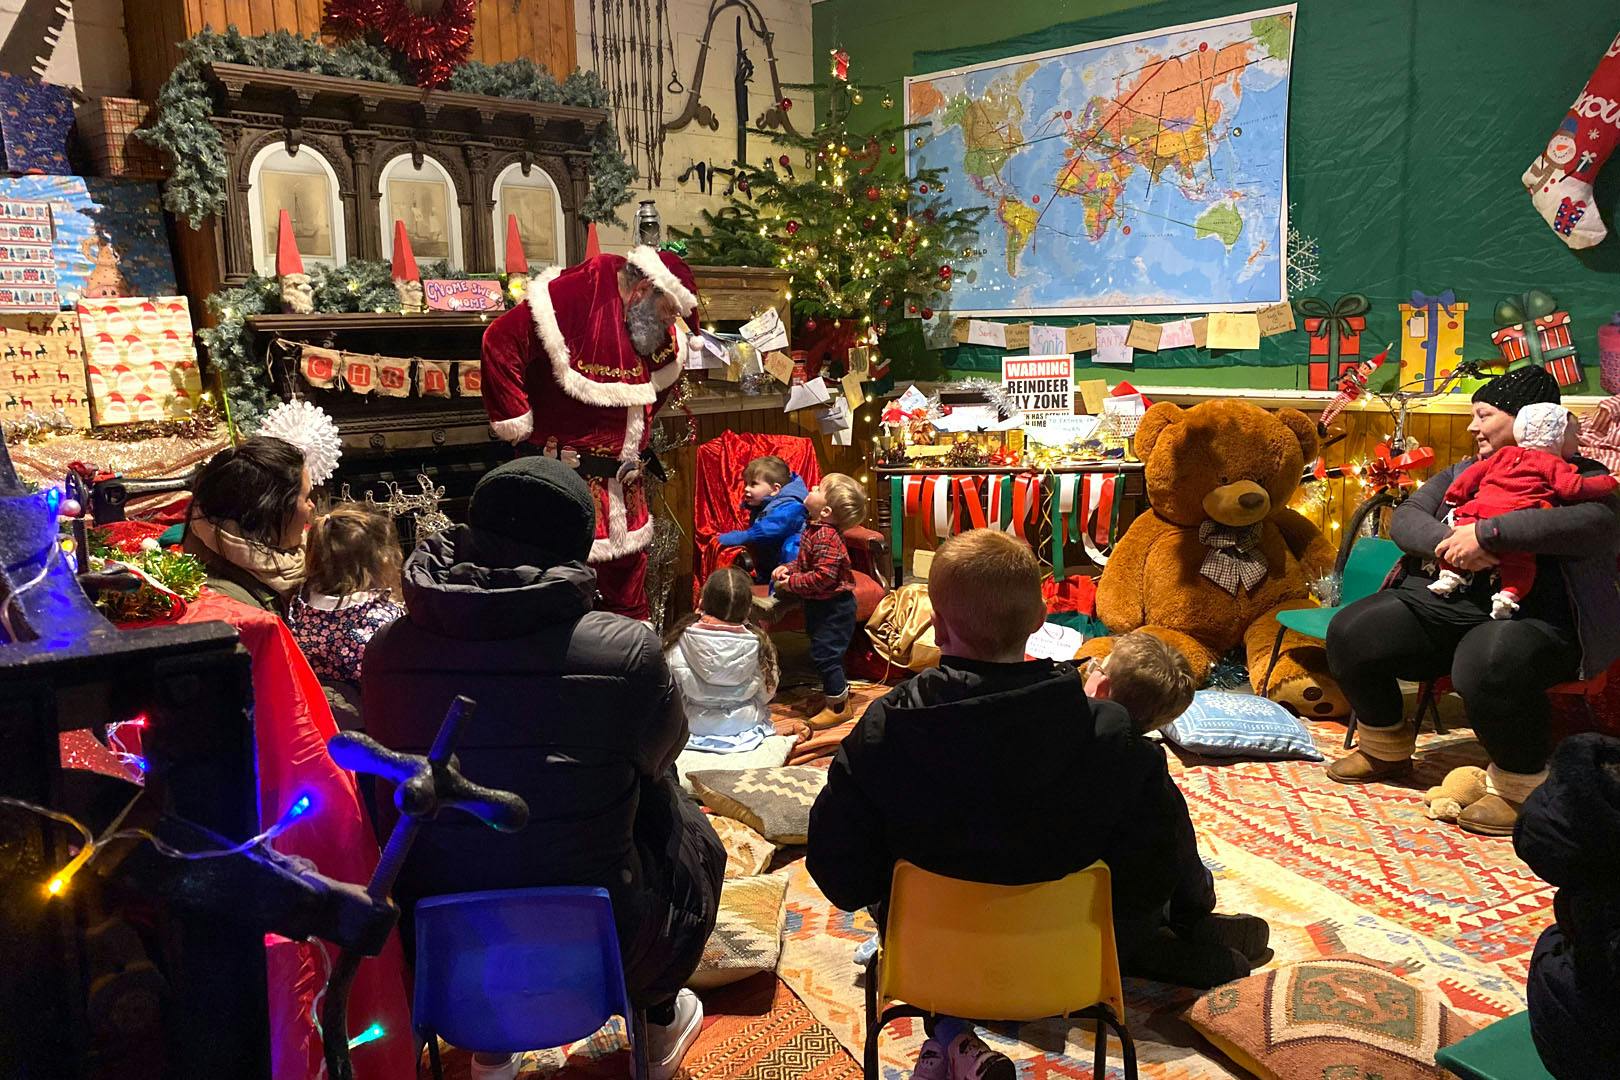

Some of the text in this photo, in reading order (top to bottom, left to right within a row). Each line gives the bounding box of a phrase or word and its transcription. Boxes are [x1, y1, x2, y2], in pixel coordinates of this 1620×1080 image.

[427, 281, 468, 302] GNOME
[1007, 361, 1068, 377] WARNING
[1008, 379, 1068, 394] REINDEER
[1011, 394, 1068, 409] LY ZONE
